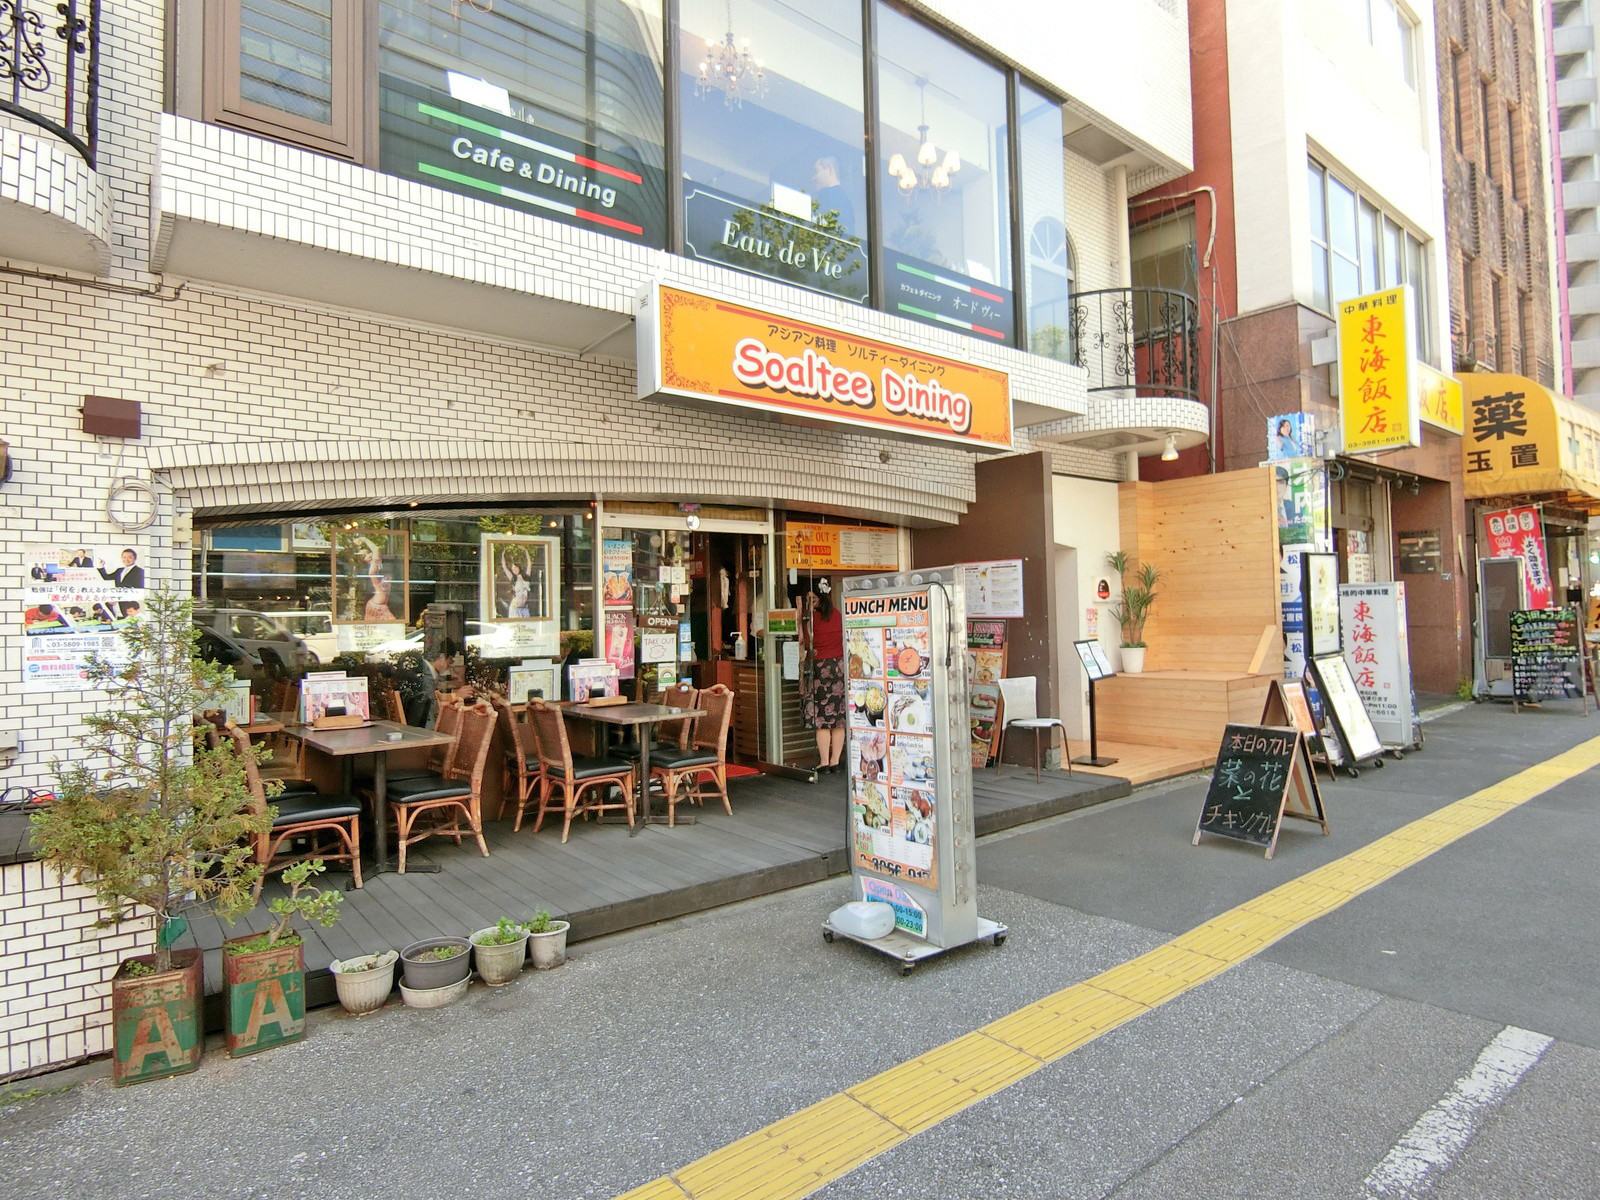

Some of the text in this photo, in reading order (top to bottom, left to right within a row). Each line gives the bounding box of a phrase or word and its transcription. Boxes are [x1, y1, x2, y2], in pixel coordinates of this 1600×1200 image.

[452, 137, 617, 208] Cafe & Dining
[721, 218, 843, 280] Eau de Vie
[1344, 294, 1397, 315] 中華料理
[767, 324, 946, 377] アジアン料理 ソルティーダイニング
[734, 340, 972, 432] Soaltee Dining
[1357, 314, 1392, 434] 東海飯店
[816, 532, 830, 541] OUT
[844, 595, 928, 615] LUNCH MENU
[647, 617, 672, 626] OPEN
[52, 640, 100, 648] 03-5809-1985
[643, 637, 675, 646] TAKE OUT
[1351, 600, 1379, 688] 東海飯店
[1228, 733, 1294, 756] 本日のカレー
[1218, 758, 1283, 791] 菜の花
[1203, 804, 1277, 834] チキンカレー
[868, 881, 893, 898] Open
